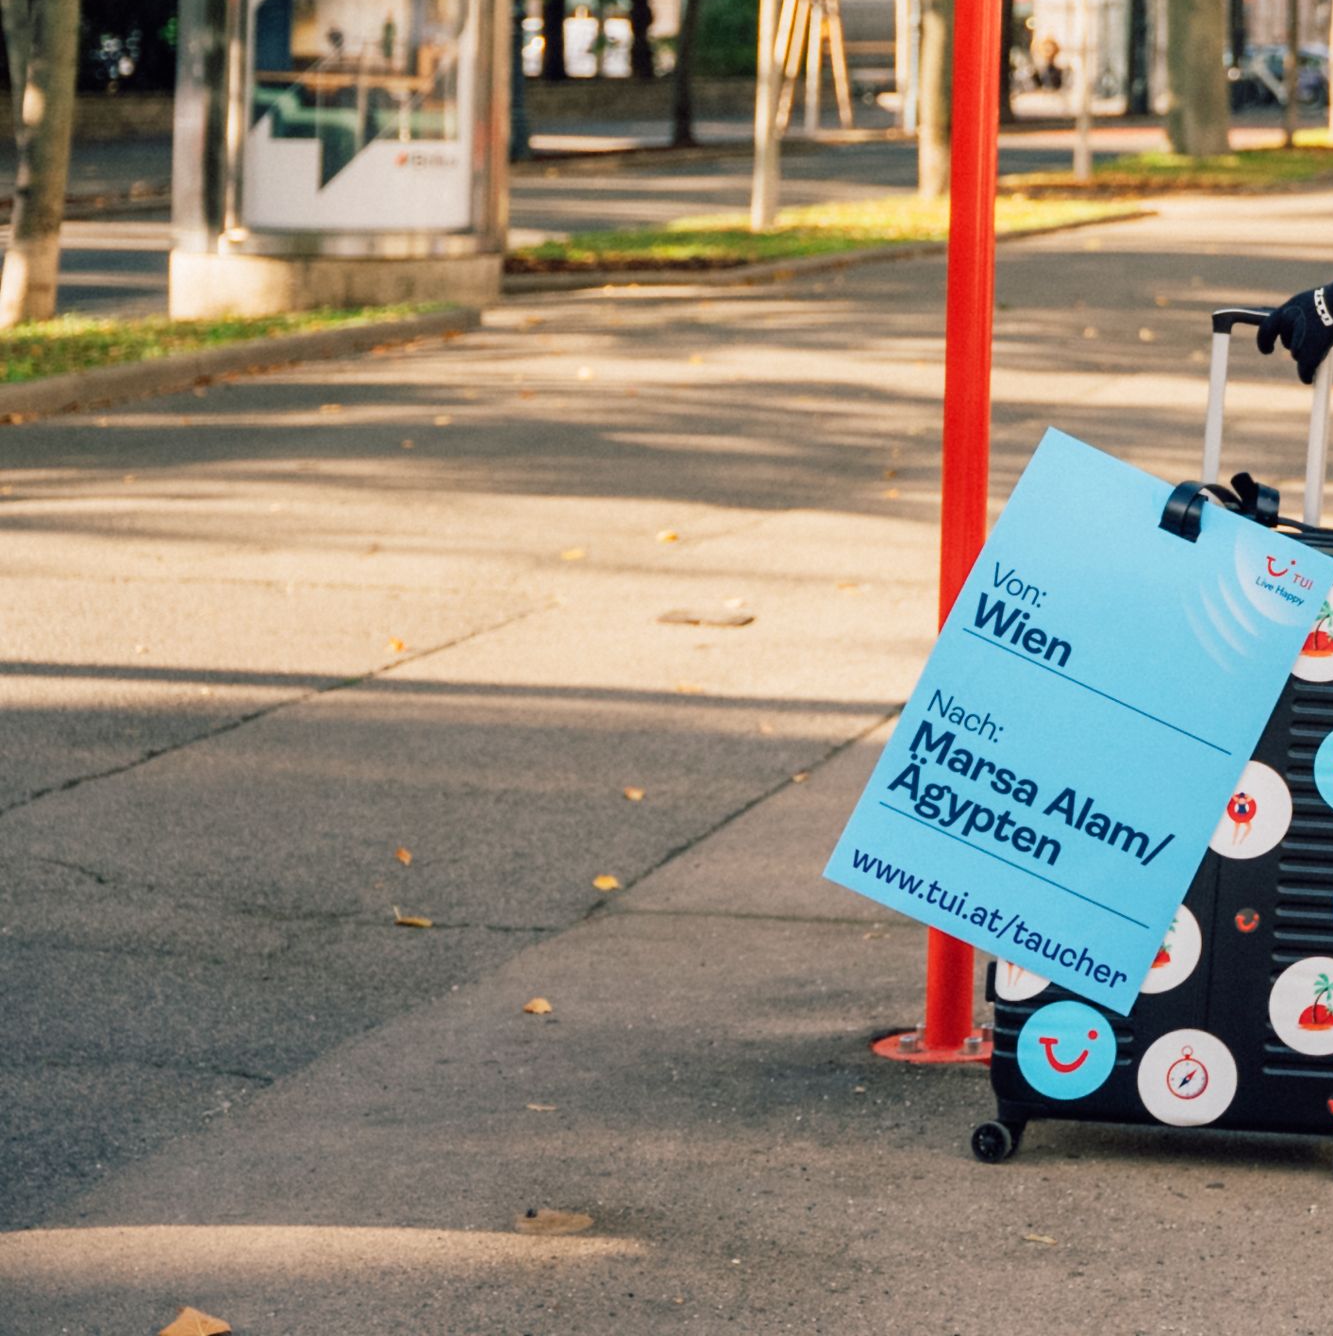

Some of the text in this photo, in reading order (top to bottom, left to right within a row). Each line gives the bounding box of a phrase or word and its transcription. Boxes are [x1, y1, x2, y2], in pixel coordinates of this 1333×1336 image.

[993, 561, 1048, 608] Von:
[1255, 576, 1305, 606] Live Happy
[1292, 573, 1314, 590] TUI
[974, 592, 1073, 668] Wien
[926, 689, 1004, 743] Nach:
[887, 752, 1063, 866] Ägypten
[908, 720, 1176, 866] Marsa Alam/
[852, 848, 1128, 990] www.tui.at/taucher
